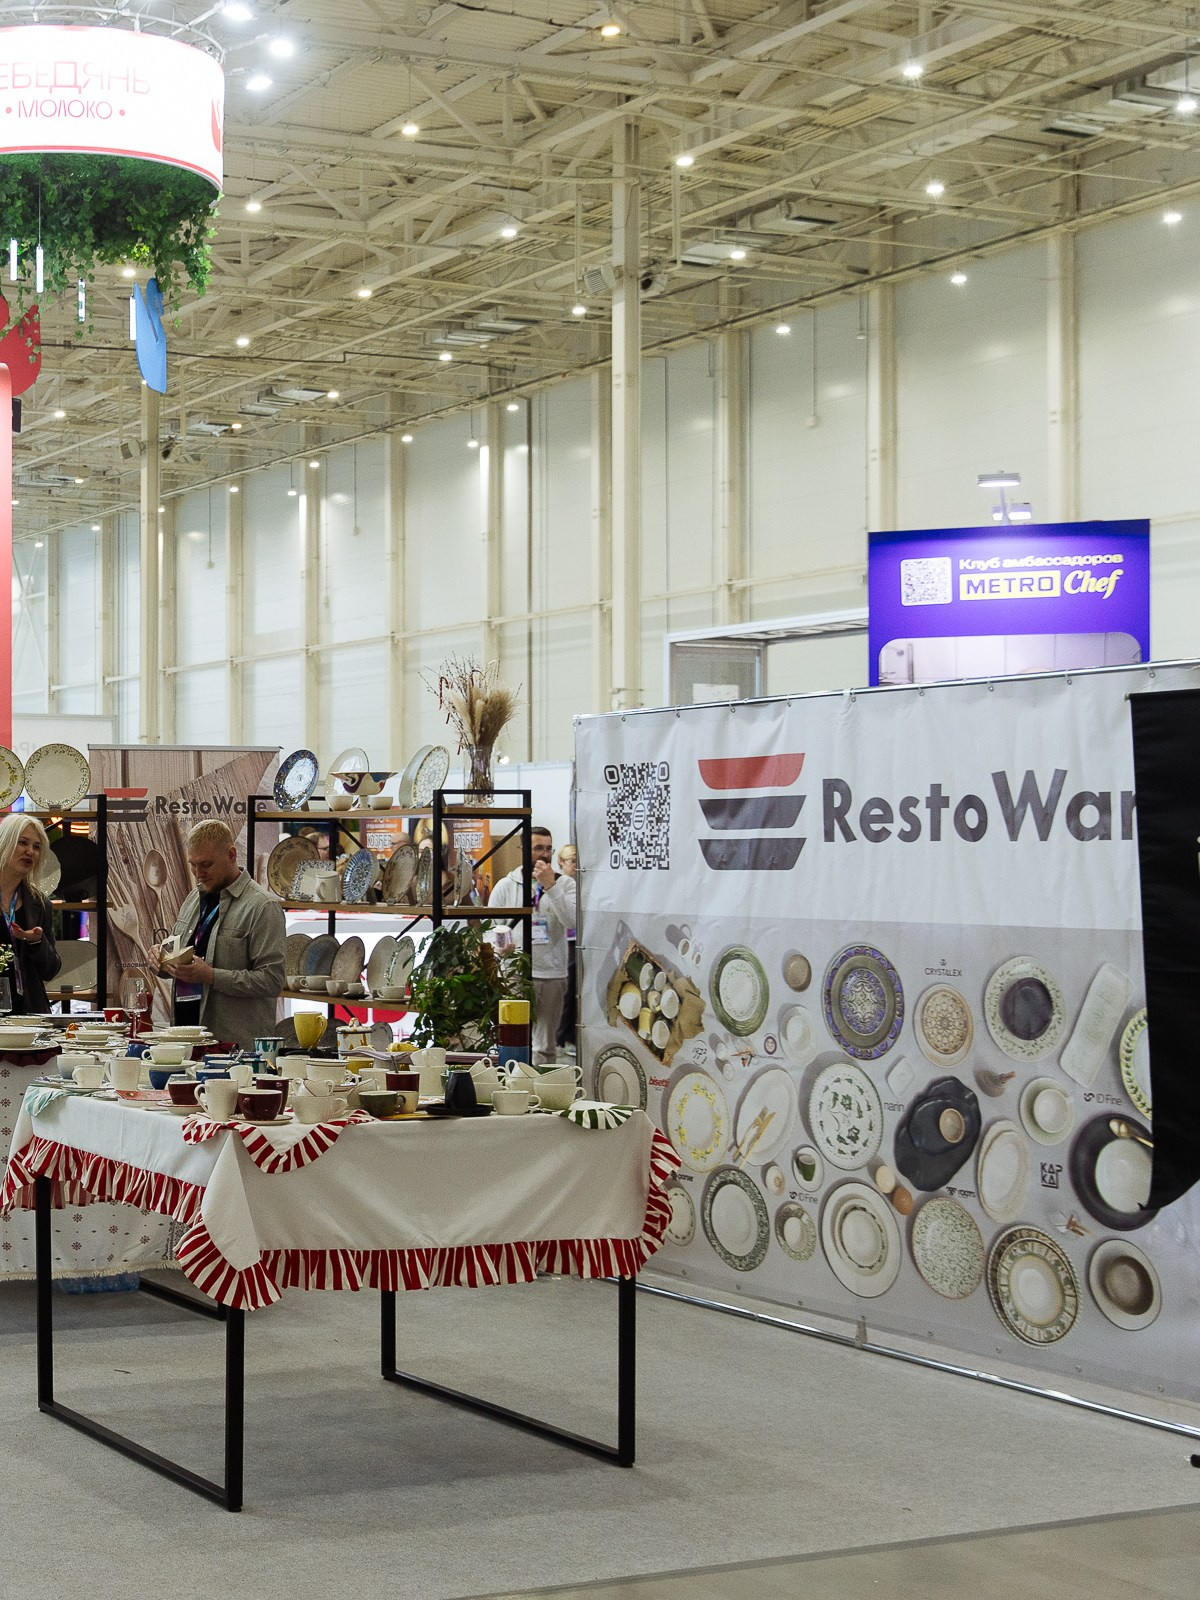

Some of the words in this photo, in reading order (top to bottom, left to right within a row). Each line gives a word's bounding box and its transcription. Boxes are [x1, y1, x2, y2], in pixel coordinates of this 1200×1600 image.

[18, 99, 113, 120] МОЛОКО
[959, 558, 1000, 571] Клуб
[1002, 553, 1124, 569] амбассадоров
[966, 576, 1055, 595] METRO
[1063, 569, 1124, 600] Chef
[155, 795, 266, 814] RestoWae
[822, 768, 1137, 843] RestoWar
